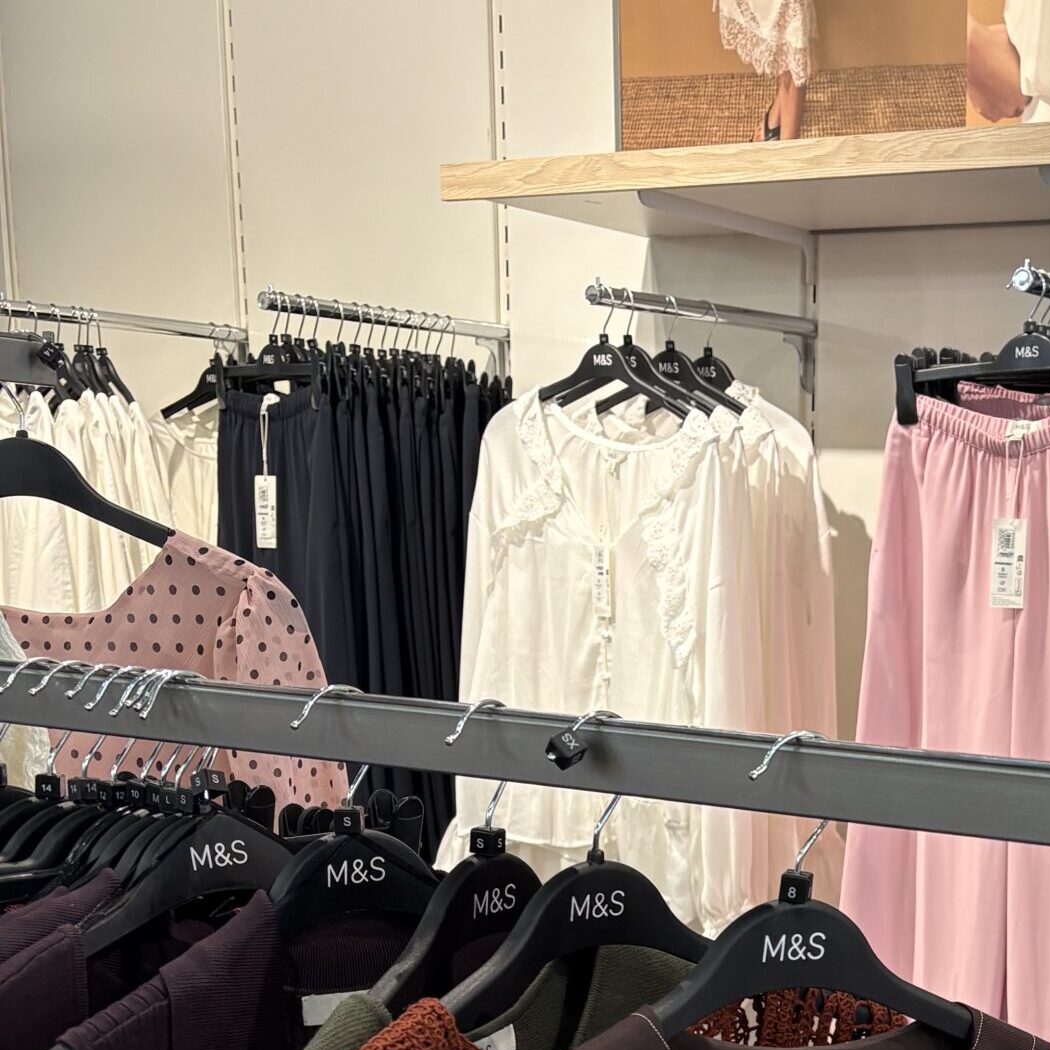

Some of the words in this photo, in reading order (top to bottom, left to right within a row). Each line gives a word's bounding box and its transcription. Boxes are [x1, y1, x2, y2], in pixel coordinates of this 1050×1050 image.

[1015, 346, 1039, 358] M&S
[263, 354, 275, 364] M&S
[593, 354, 613, 366] M&S
[659, 362, 680, 374] M&S
[697, 366, 717, 378] M&S
[561, 732, 580, 750] XS
[195, 776, 201, 787] S
[211, 773, 220, 784] S
[41, 783, 52, 792] 14
[86, 783, 97, 792] 14
[115, 791, 125, 800] 12
[131, 789, 140, 799] 10
[152, 793, 160, 803] M
[165, 795, 171, 804] L
[180, 794, 187, 805] S
[343, 816, 352, 827] S
[476, 838, 485, 849] S
[497, 838, 503, 848] S
[190, 839, 248, 871] M&S
[327, 856, 386, 888] M&S
[787, 886, 797, 899] 8
[473, 883, 516, 920] M&S
[570, 890, 625, 922] M&S
[762, 932, 827, 963] M&S
